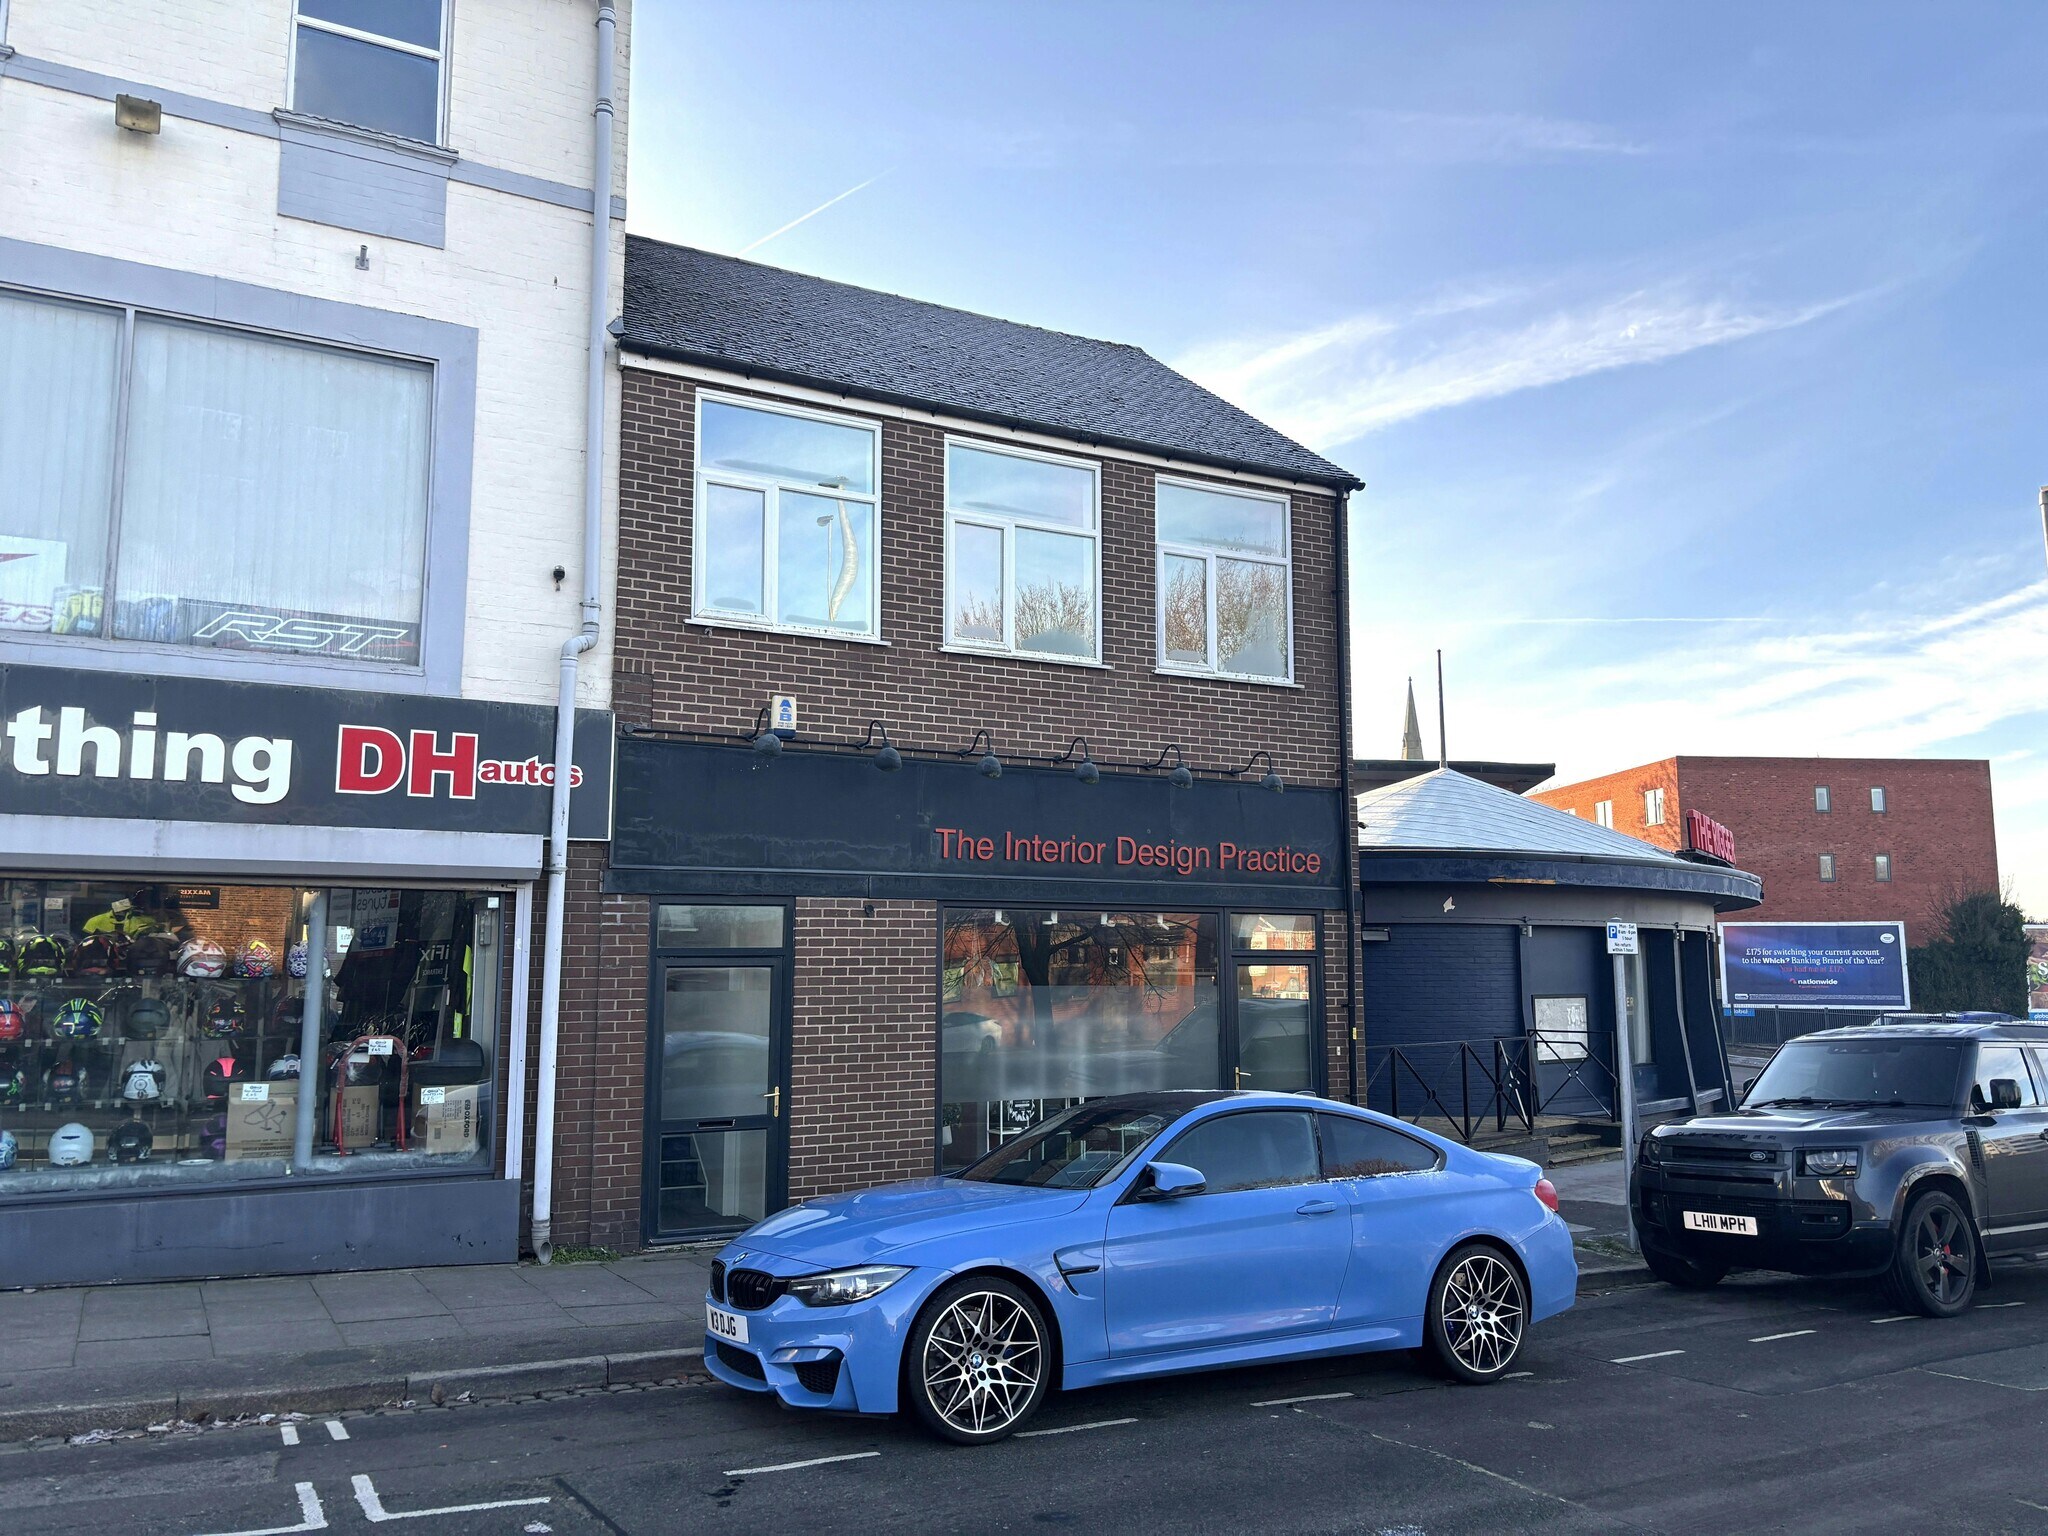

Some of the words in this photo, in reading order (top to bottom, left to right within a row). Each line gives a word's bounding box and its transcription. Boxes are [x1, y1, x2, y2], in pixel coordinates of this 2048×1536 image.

[192, 611, 408, 652] RST
[0, 705, 293, 804] thing
[335, 724, 479, 801] DH
[935, 827, 994, 860] The
[1005, 831, 1106, 865] Interior
[1116, 836, 1210, 876] Design
[1219, 841, 1321, 874] Practice
[1687, 809, 1714, 854] THE
[1774, 948, 1806, 957] switching
[1792, 957, 1821, 965] Banking
[1693, 1214, 1717, 1228] LH11
[1720, 1216, 1747, 1232] MPH
[720, 1313, 736, 1336] DJG
